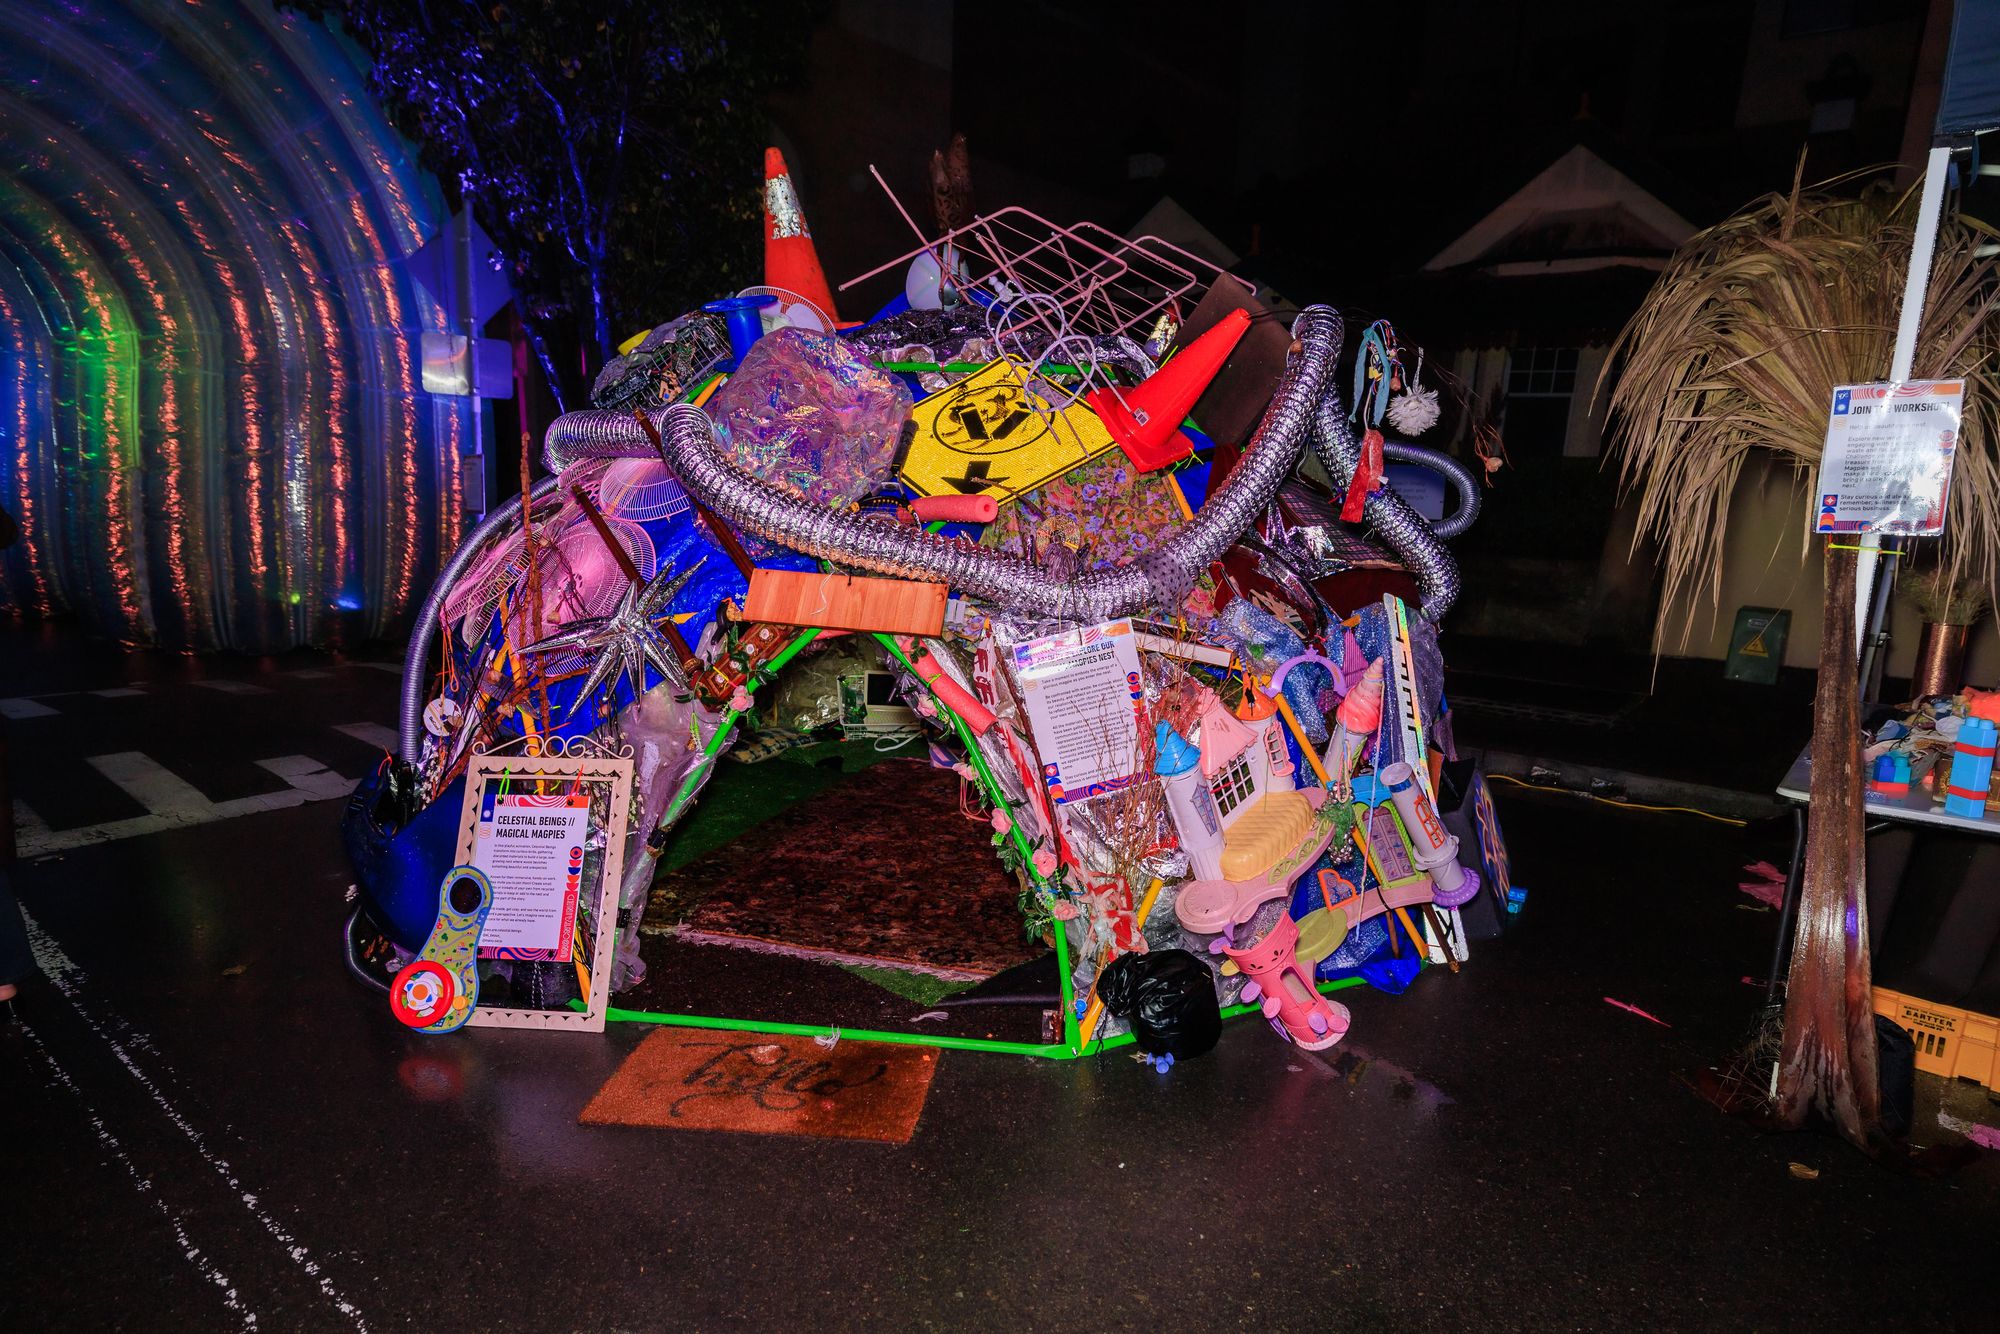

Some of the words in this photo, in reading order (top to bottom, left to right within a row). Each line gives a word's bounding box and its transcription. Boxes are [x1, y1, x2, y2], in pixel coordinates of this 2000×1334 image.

[1851, 405, 1871, 414] JOIN
[497, 815, 537, 826] CELESTIAL
[538, 816, 567, 827] BEINGS
[496, 828, 530, 839] MAGICAL
[531, 829, 566, 840] MAGPIES
